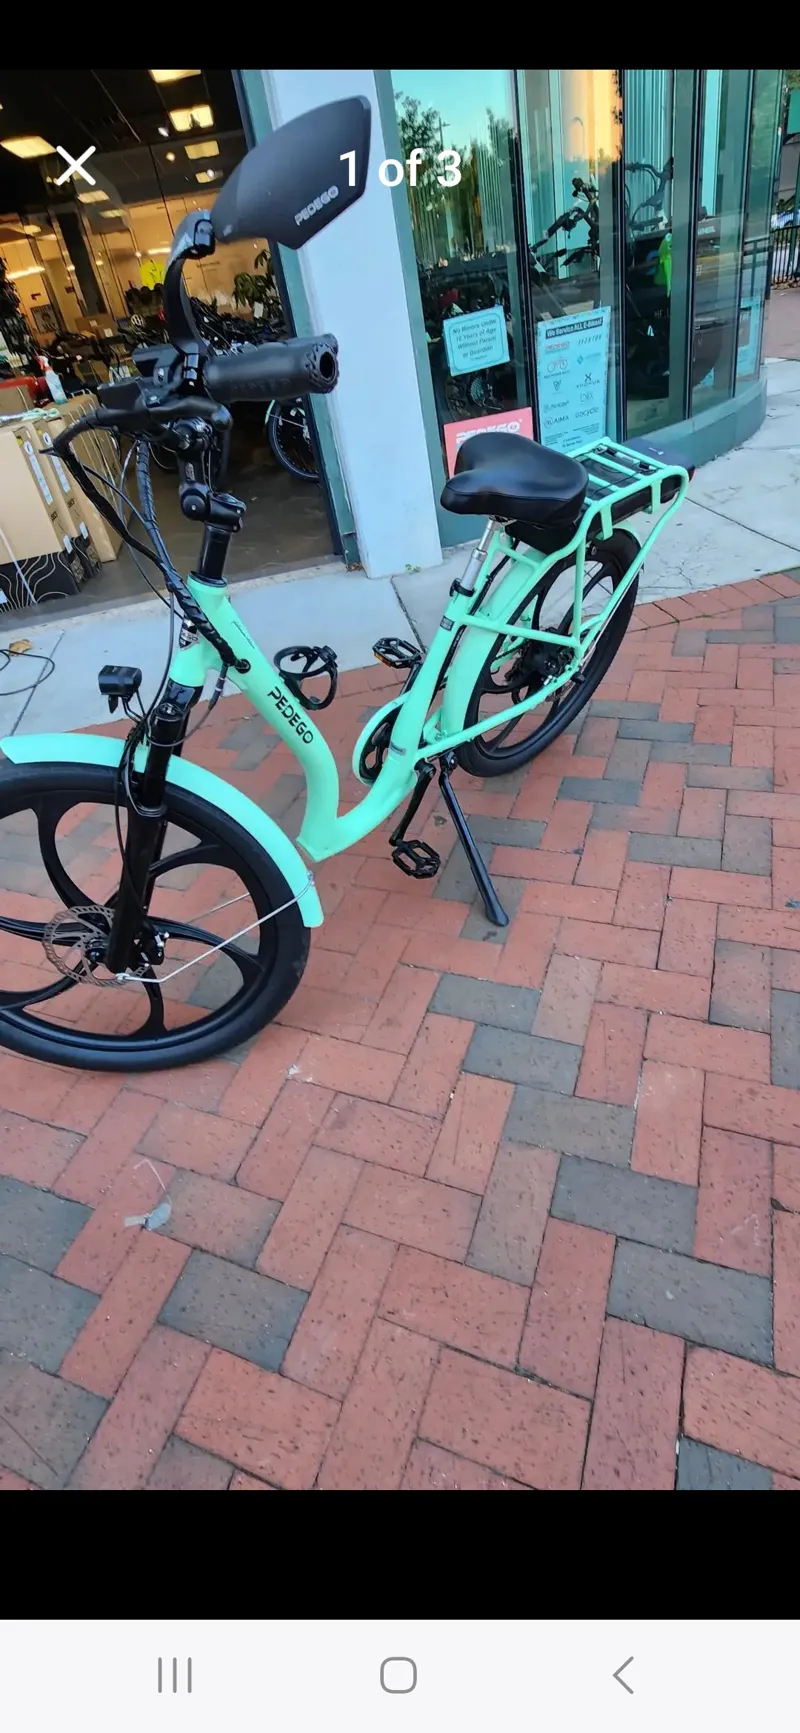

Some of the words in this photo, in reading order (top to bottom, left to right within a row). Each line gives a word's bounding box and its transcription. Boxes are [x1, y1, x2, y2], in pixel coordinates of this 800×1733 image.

[294, 185, 339, 226] PEDEGO
[556, 326, 574, 335] Service
[574, 322, 583, 331] ALL
[267, 686, 314, 744] PEDEGO
